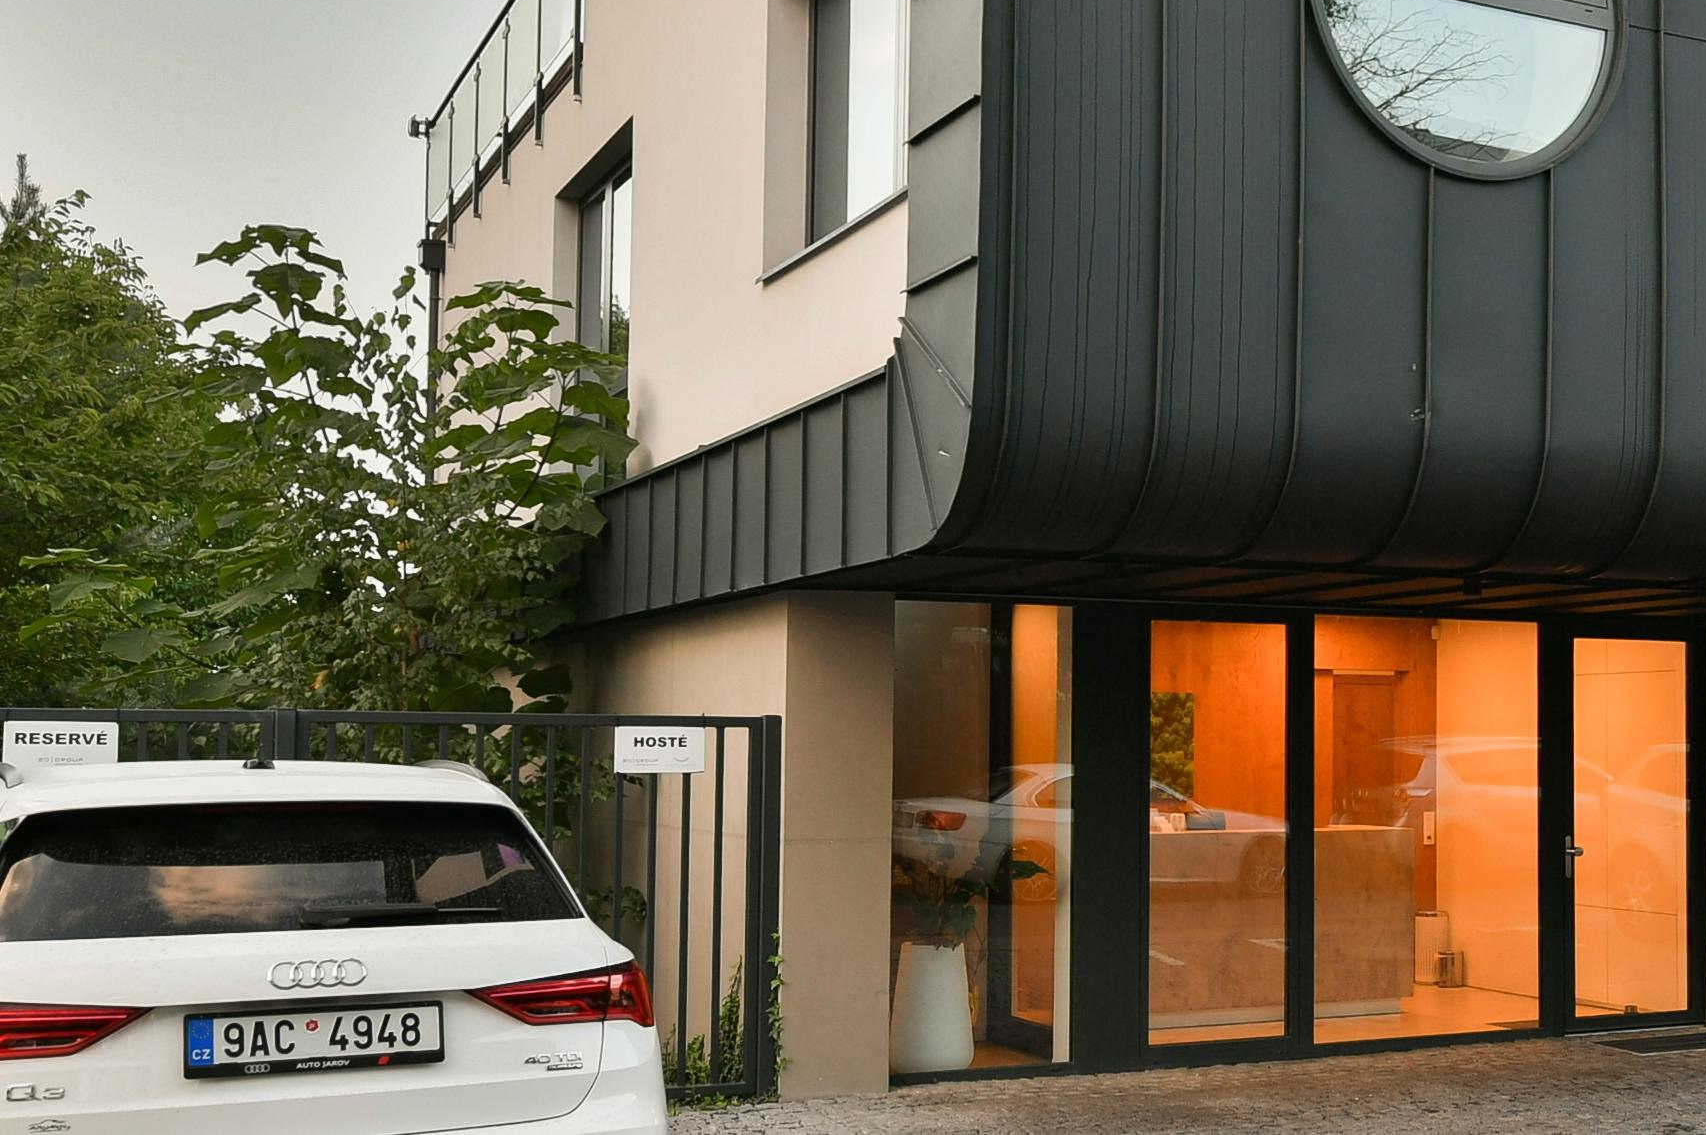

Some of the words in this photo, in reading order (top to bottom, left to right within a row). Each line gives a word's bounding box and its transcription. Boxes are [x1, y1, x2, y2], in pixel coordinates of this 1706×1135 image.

[14, 730, 108, 745] RESERVÉ
[633, 734, 688, 748] HOSTÉ
[223, 1019, 296, 1058] 9AC
[328, 1012, 421, 1051] 4948
[191, 1049, 211, 1060] CZ
[524, 1055, 551, 1064] 40
[296, 1061, 321, 1069] AUTO
[6, 1084, 66, 1102] Q3
